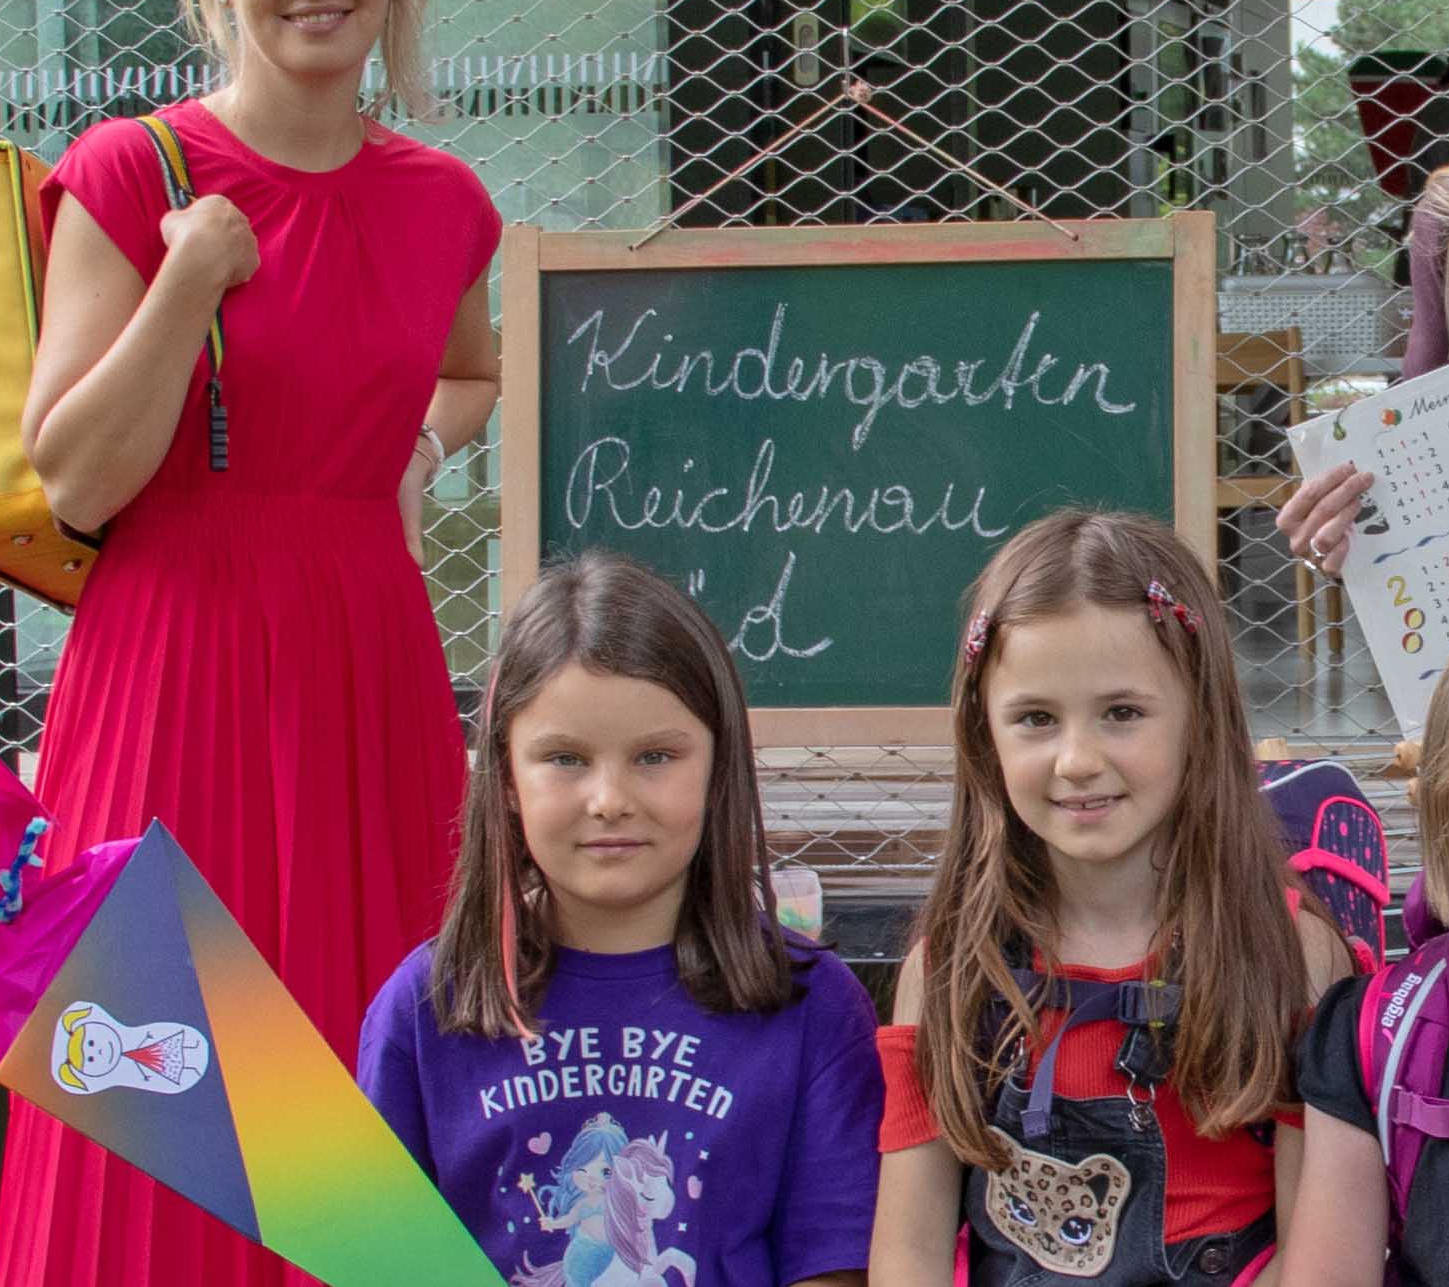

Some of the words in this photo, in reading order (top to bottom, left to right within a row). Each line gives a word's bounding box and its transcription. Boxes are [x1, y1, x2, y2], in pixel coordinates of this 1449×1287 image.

[566, 302, 1136, 450] Kindergarten
[565, 437, 1009, 537] Reichenau
[1381, 972, 1423, 1028] ergobag
[519, 1027, 602, 1066] BYE
[622, 1026, 702, 1068] BYE
[479, 1064, 734, 1120] KINDERGARTEN
